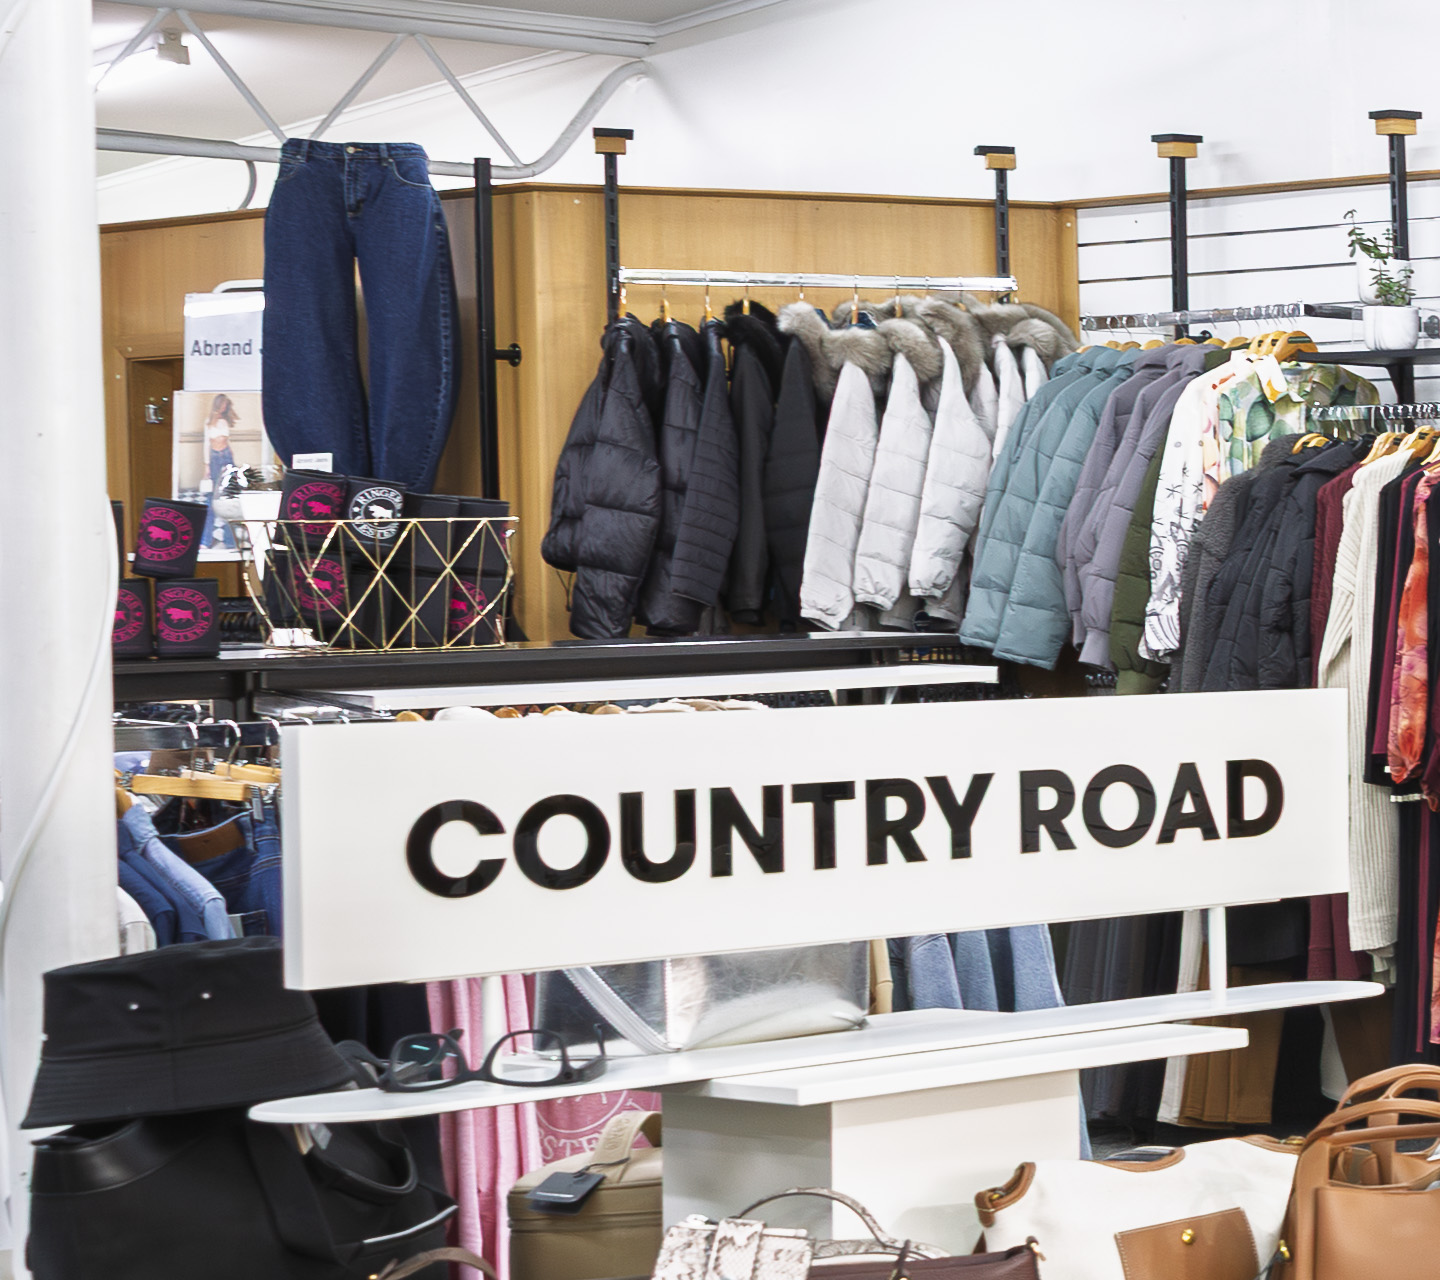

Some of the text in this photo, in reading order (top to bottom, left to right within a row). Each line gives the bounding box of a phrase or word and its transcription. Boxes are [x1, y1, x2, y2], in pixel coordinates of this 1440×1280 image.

[190, 339, 253, 356] Abrand
[405, 759, 1284, 899] COUNTRY ROAD
